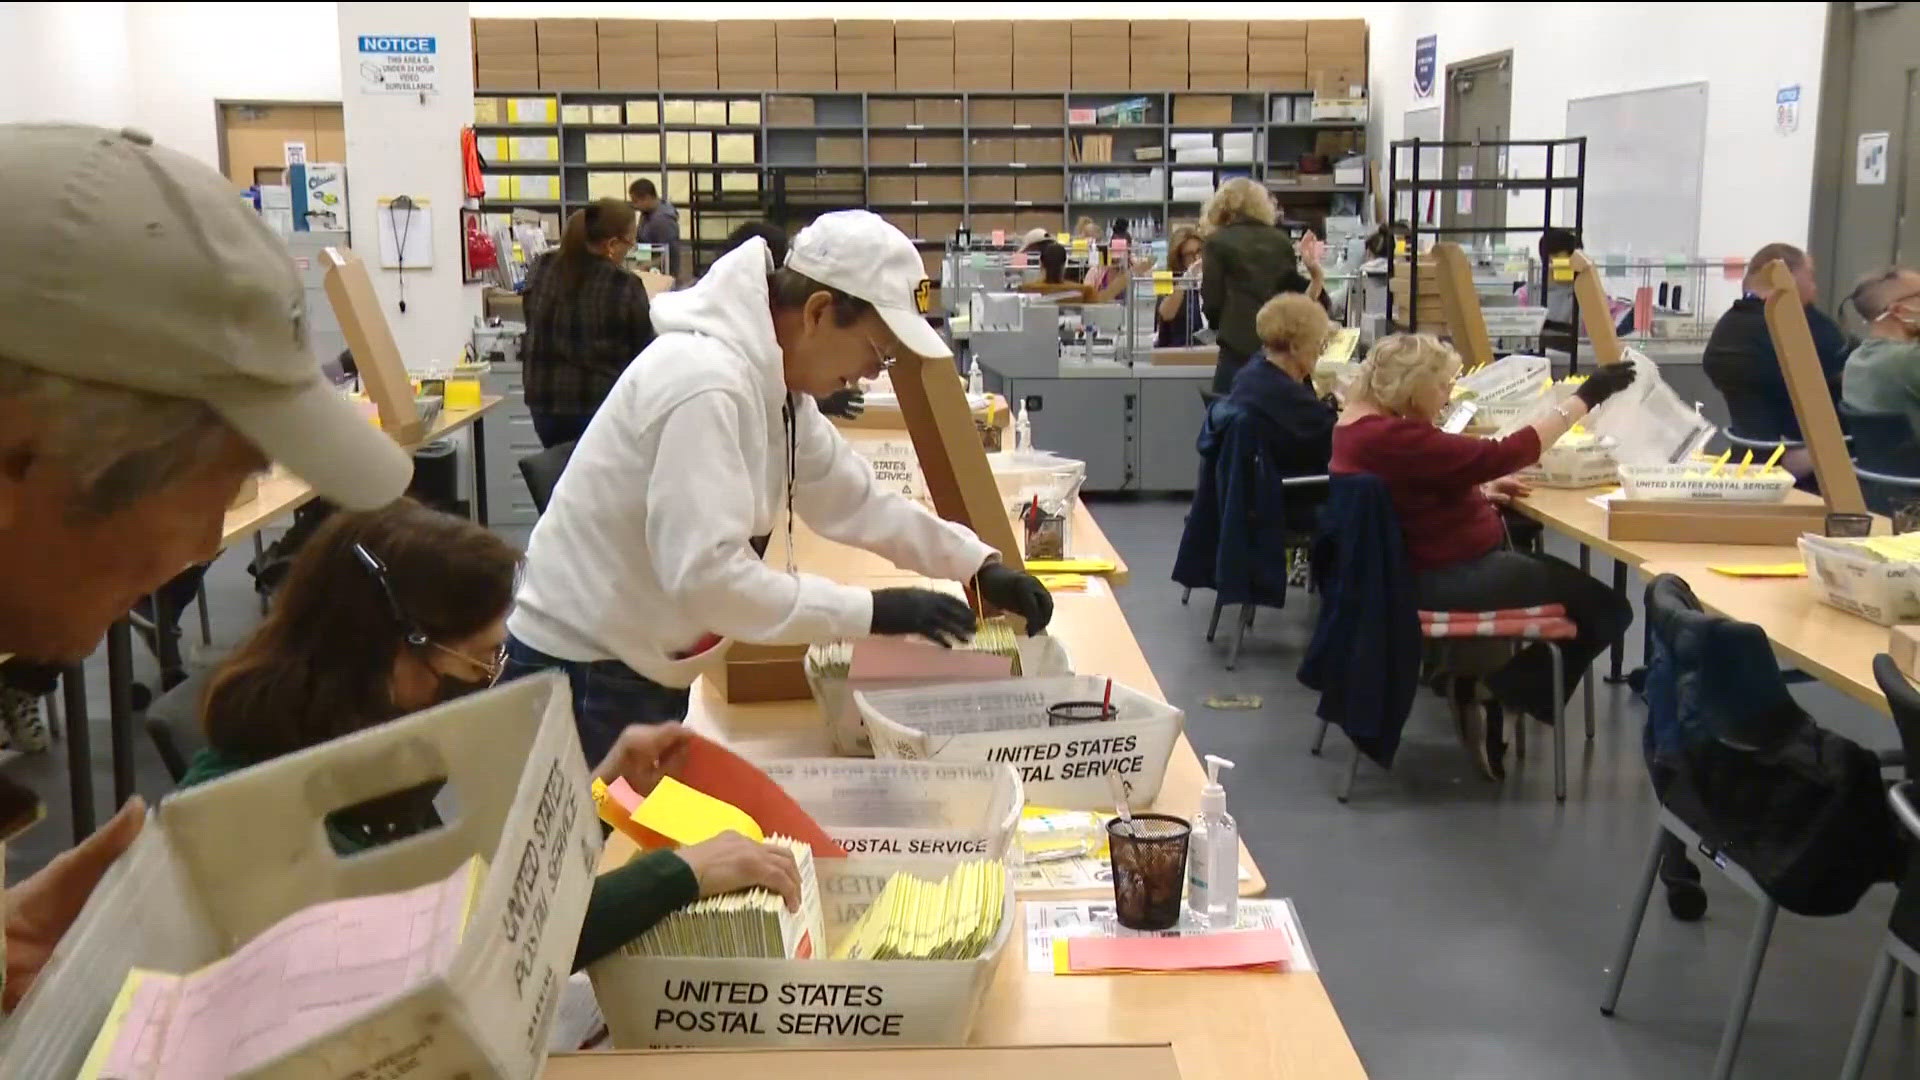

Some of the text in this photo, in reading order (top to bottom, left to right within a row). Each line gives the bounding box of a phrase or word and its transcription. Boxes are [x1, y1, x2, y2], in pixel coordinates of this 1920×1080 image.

[364, 38, 430, 51] NOTICE
[400, 74, 419, 82] VIDEO
[872, 461, 906, 470] STATES
[1636, 480, 1783, 490] UNITED STATES POSTAL SERVICE
[986, 735, 1138, 763] UNITED STATES
[1015, 755, 1144, 783] TAL SERVICE
[502, 757, 565, 943] UNITED STATES
[908, 839, 989, 854] SERVICE
[514, 782, 578, 1000] POSTAL SERVICE
[664, 979, 884, 1007] UNITED STATES
[654, 1008, 905, 1037] POSTAL SERVICE
